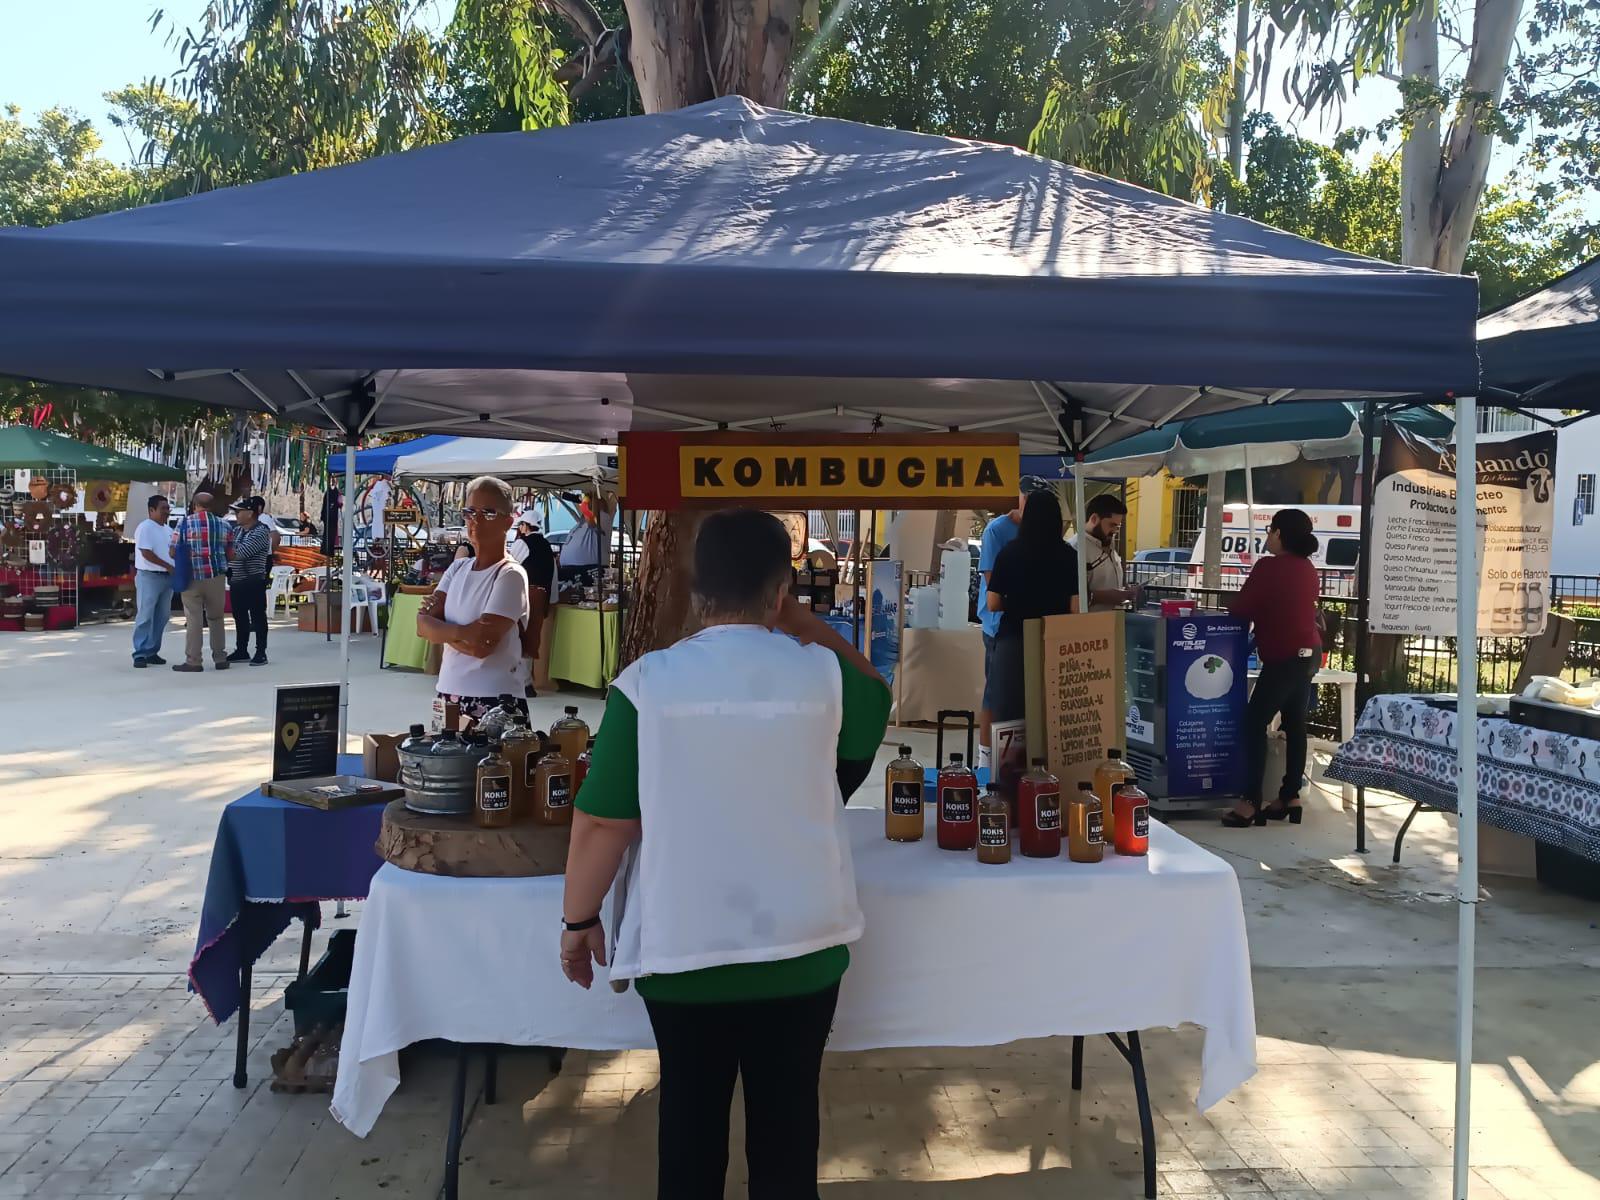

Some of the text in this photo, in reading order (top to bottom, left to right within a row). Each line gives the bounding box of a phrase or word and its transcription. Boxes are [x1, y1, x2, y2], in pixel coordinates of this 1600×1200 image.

[694, 457, 1004, 488] KOMBUCHA
[1392, 480, 1447, 498] Industrias
[1410, 499, 1449, 514] Productos
[1487, 568, 1508, 580] Solo
[1059, 638, 1109, 656] SABORES
[1059, 685, 1089, 699] MANGO
[1060, 722, 1103, 740] MANDARINA
[485, 790, 508, 799] KOKIS
[895, 796, 918, 804] KOKIS
[945, 802, 970, 811] KOKIS
